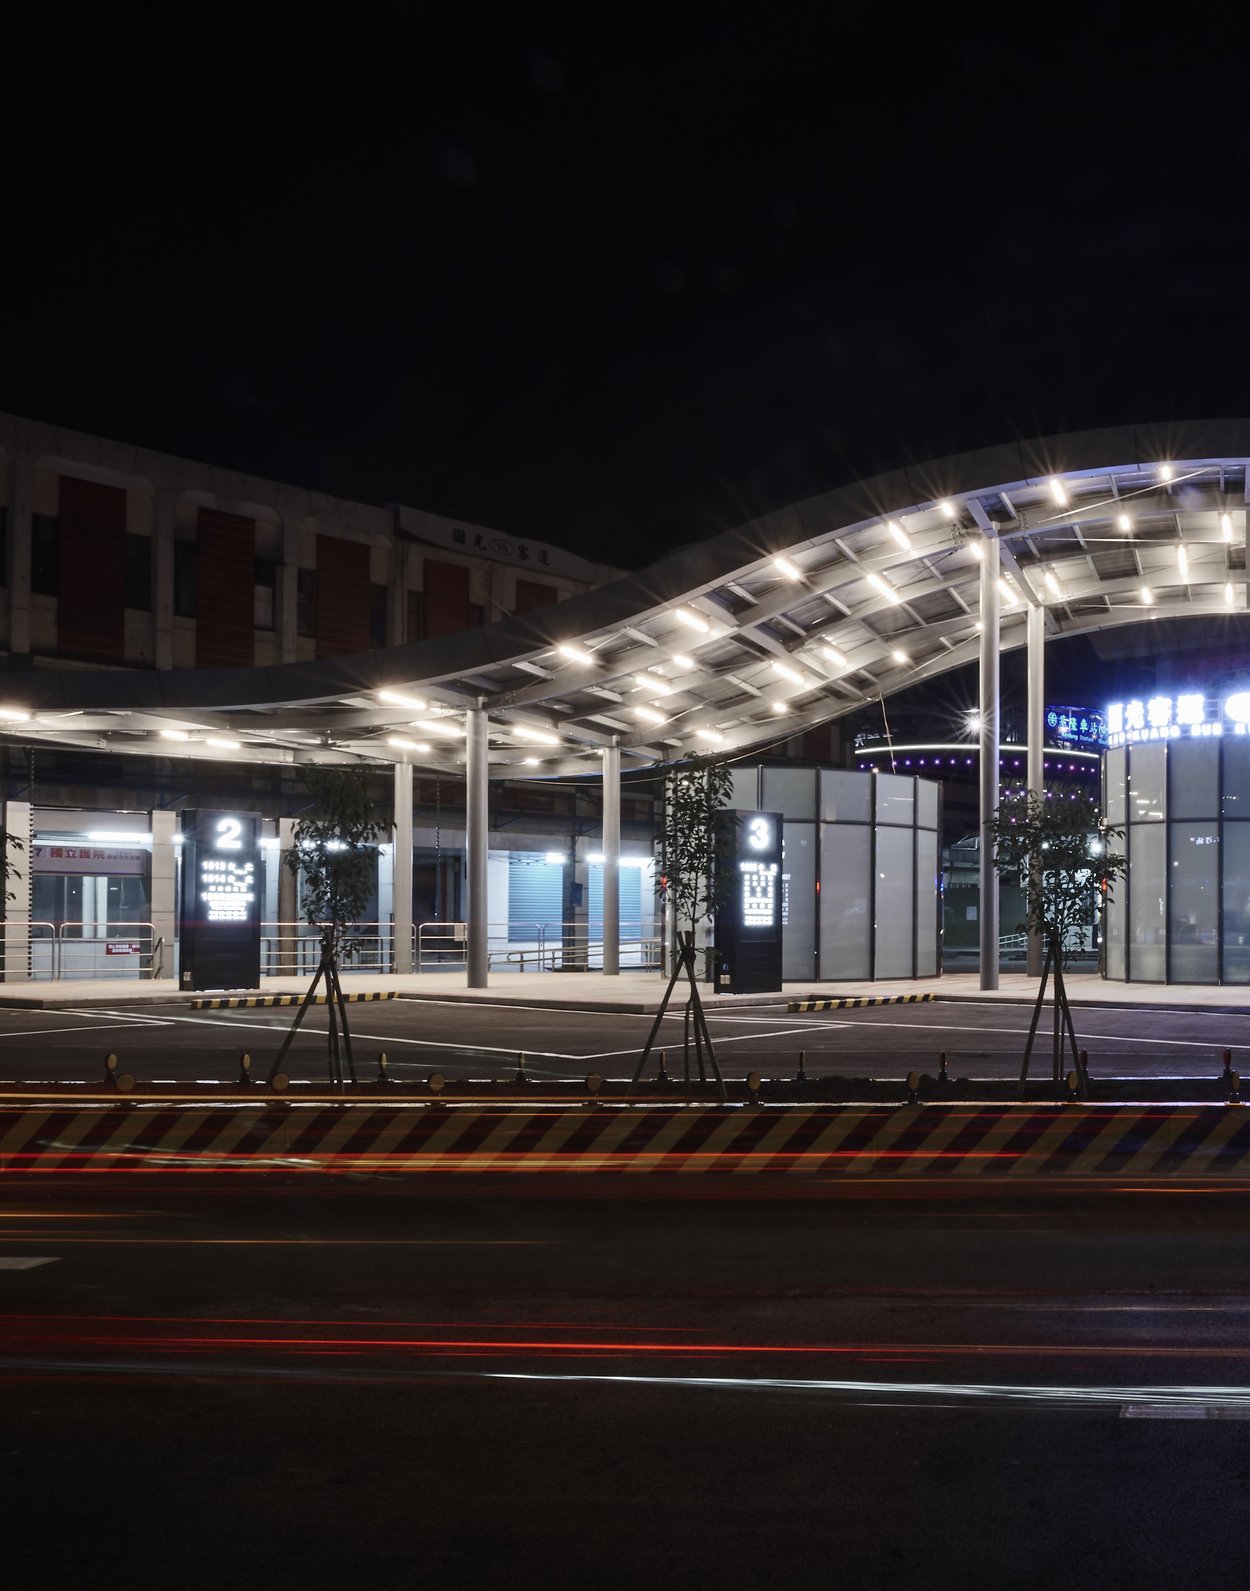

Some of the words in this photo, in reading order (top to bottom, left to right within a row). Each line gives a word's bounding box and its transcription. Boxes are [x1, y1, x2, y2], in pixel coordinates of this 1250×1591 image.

[1191, 723, 1222, 737] BUS
[217, 819, 241, 848] 2
[750, 818, 769, 850] 3
